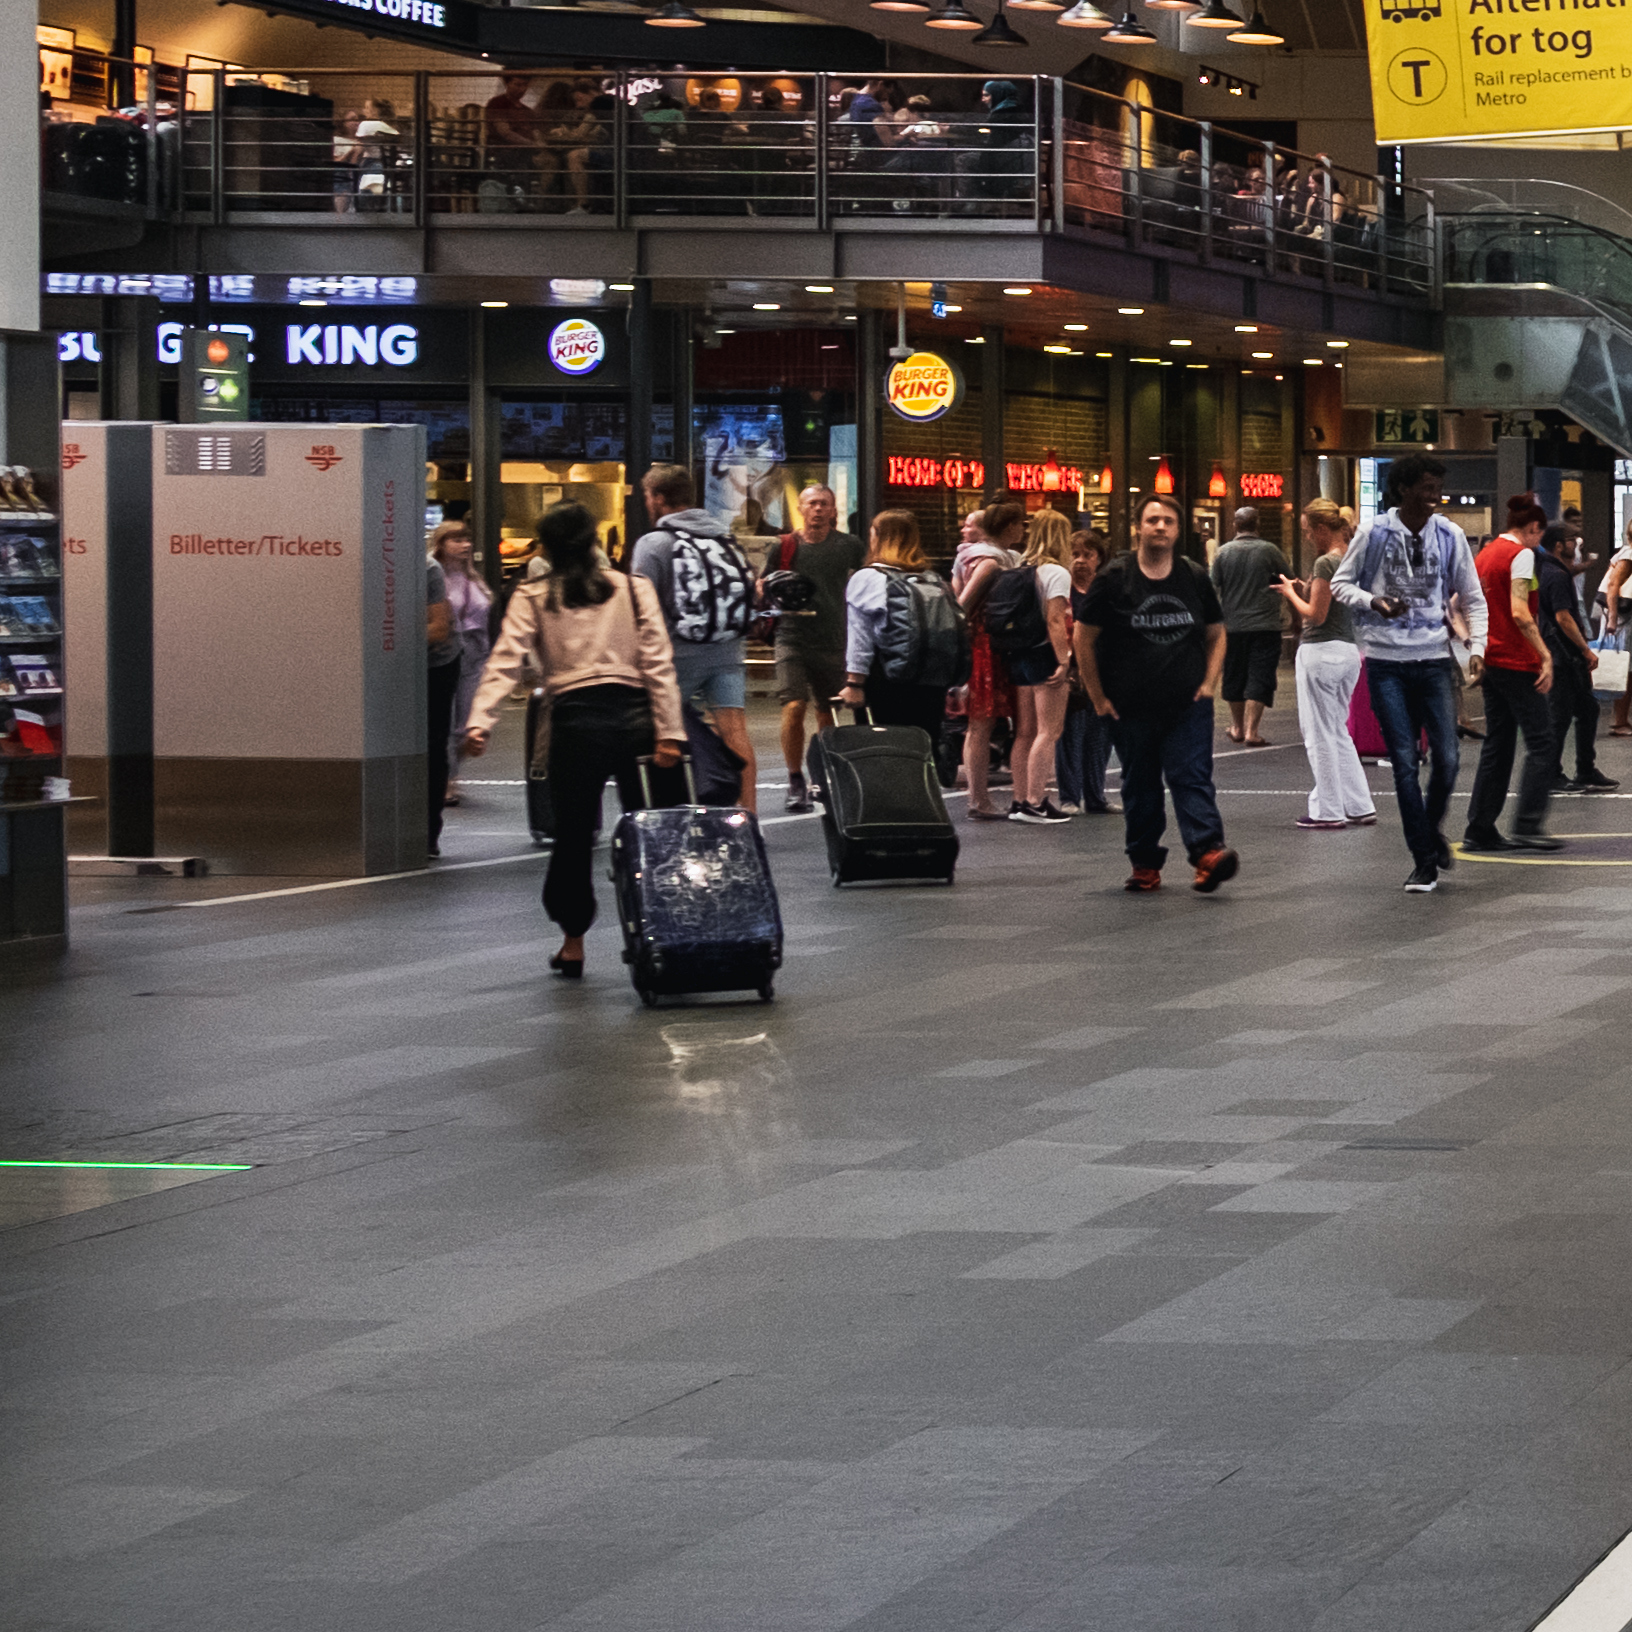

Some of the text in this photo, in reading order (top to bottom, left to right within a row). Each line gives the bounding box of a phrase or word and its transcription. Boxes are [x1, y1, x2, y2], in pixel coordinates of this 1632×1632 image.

[1470, 26, 1594, 60] for tog
[1474, 70, 1515, 86] Rail
[1520, 63, 1616, 87] replacement
[1476, 90, 1527, 107] Metro
[286, 323, 419, 366] KING
[555, 331, 597, 345] BURGER
[555, 341, 598, 360] KING
[894, 368, 949, 383] BURGER
[893, 381, 949, 400] KING
[311, 445, 335, 455] NSB
[169, 534, 343, 557] Billetter/Tickets
[384, 479, 395, 652] Billetter/Tickets
